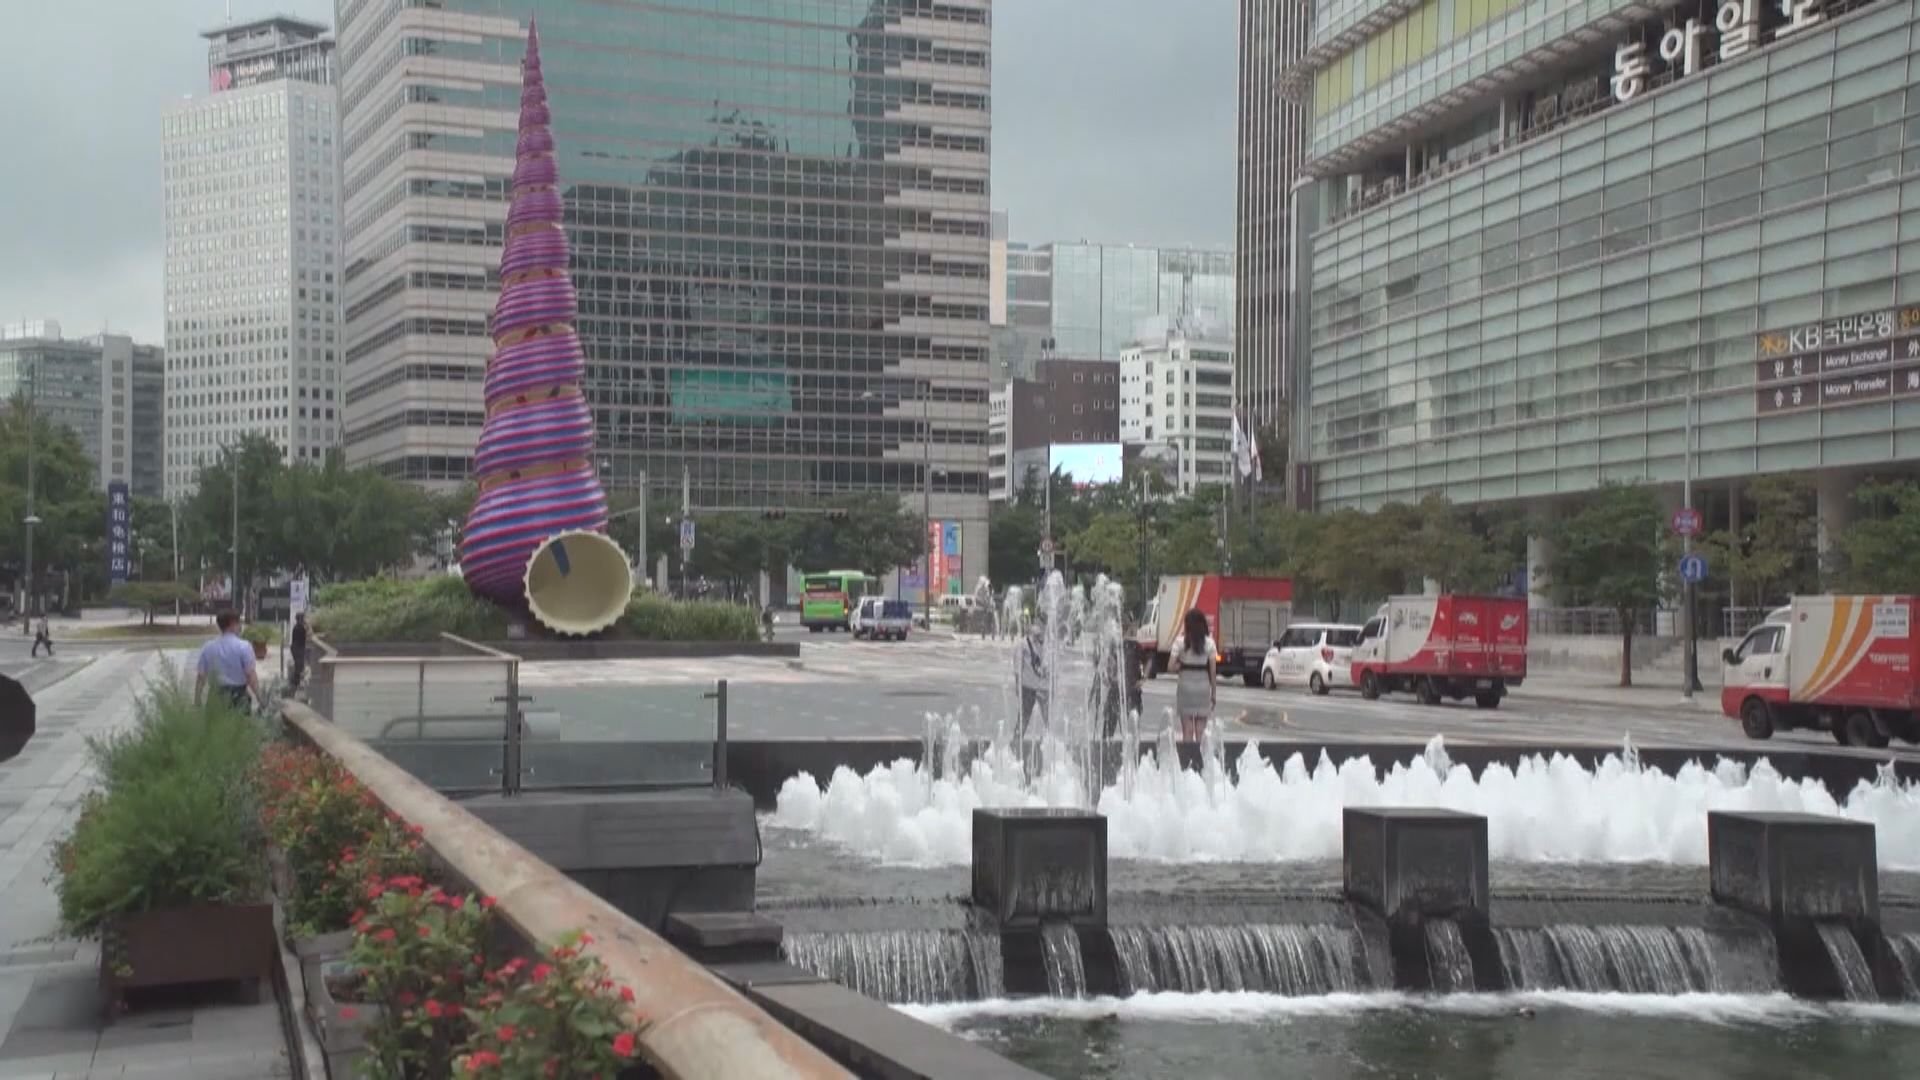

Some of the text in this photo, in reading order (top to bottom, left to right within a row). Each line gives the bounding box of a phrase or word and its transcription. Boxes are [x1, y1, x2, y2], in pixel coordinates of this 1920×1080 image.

[1825, 353, 1849, 368] Money
[1851, 348, 1888, 363] Exchange
[1825, 382, 1851, 396] Money
[1853, 377, 1887, 392] Transfer
